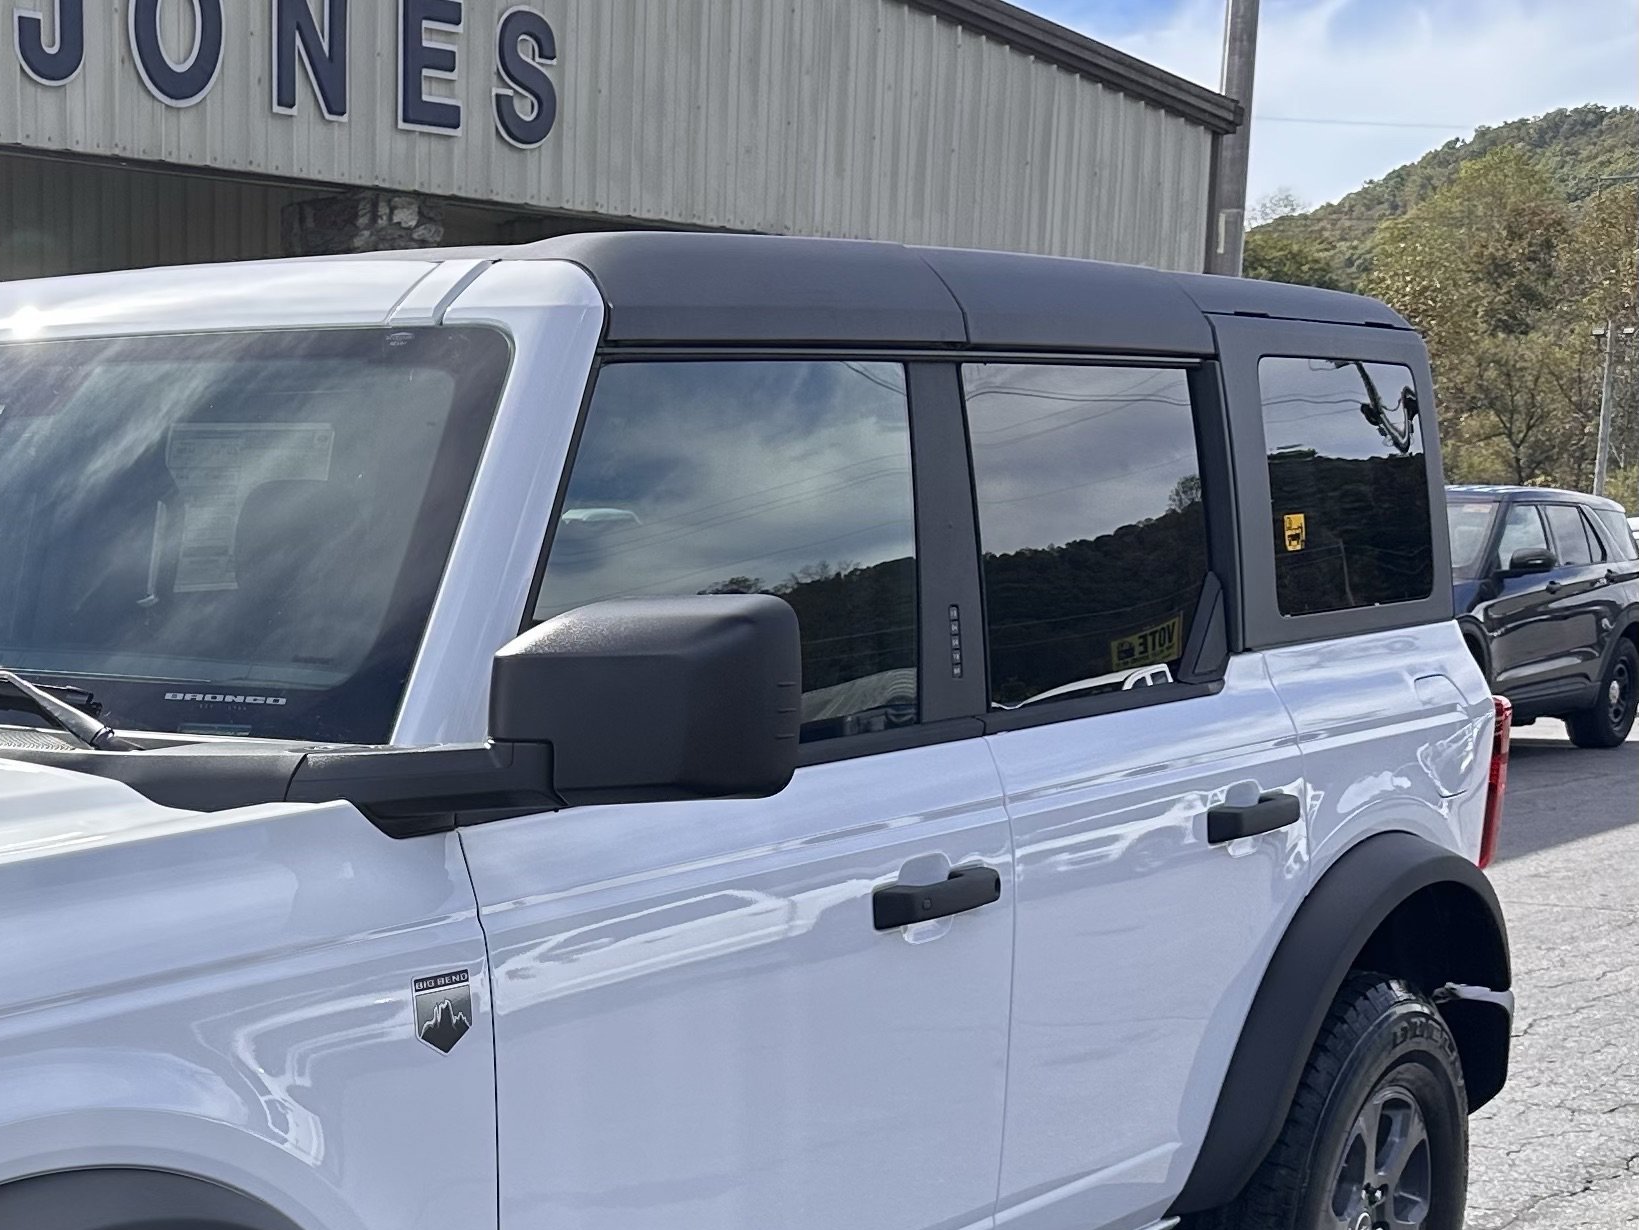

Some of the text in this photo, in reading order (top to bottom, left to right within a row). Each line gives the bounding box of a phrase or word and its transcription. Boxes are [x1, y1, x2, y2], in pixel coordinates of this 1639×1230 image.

[13, 0, 558, 150] JONES
[164, 692, 287, 705] BRONCO
[415, 972, 468, 990] BIG BEND
